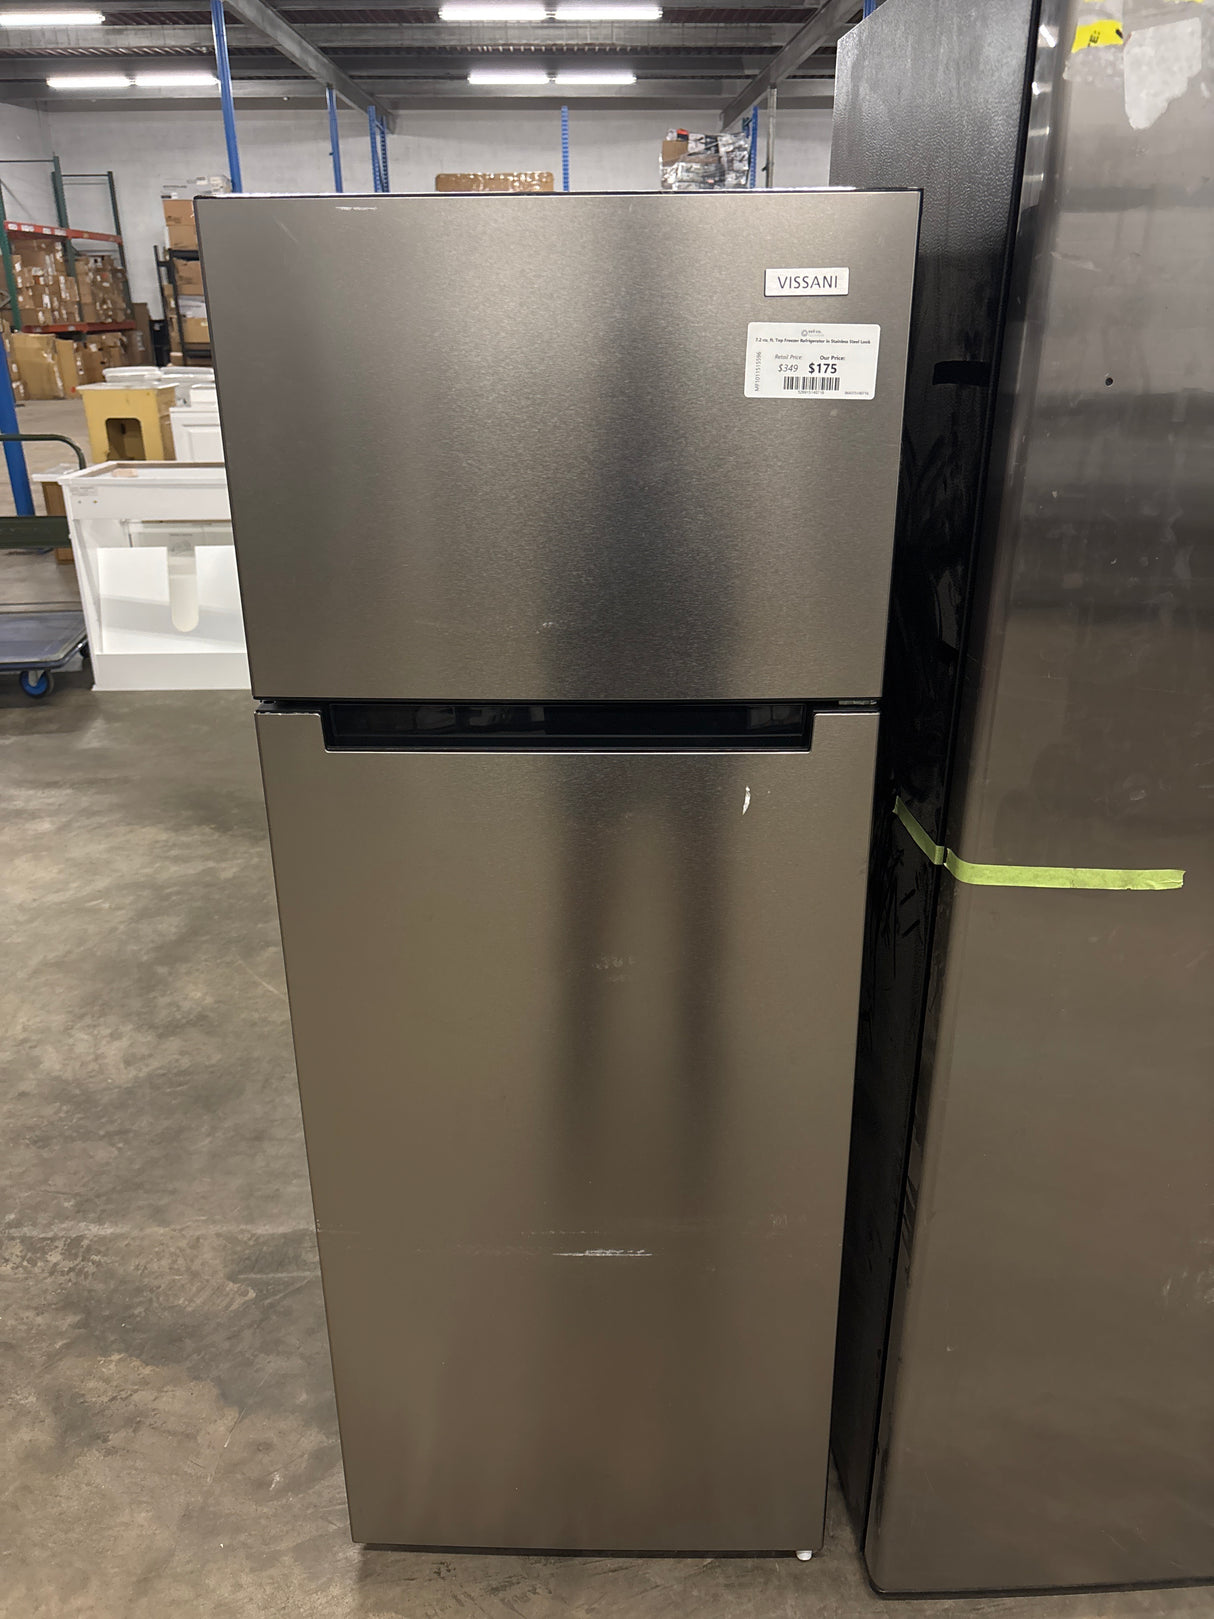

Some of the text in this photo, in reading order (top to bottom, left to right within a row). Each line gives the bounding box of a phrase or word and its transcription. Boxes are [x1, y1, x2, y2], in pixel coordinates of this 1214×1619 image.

[777, 275, 838, 289] VISSANI
[777, 363, 799, 373] $349
[808, 361, 837, 375] $175
